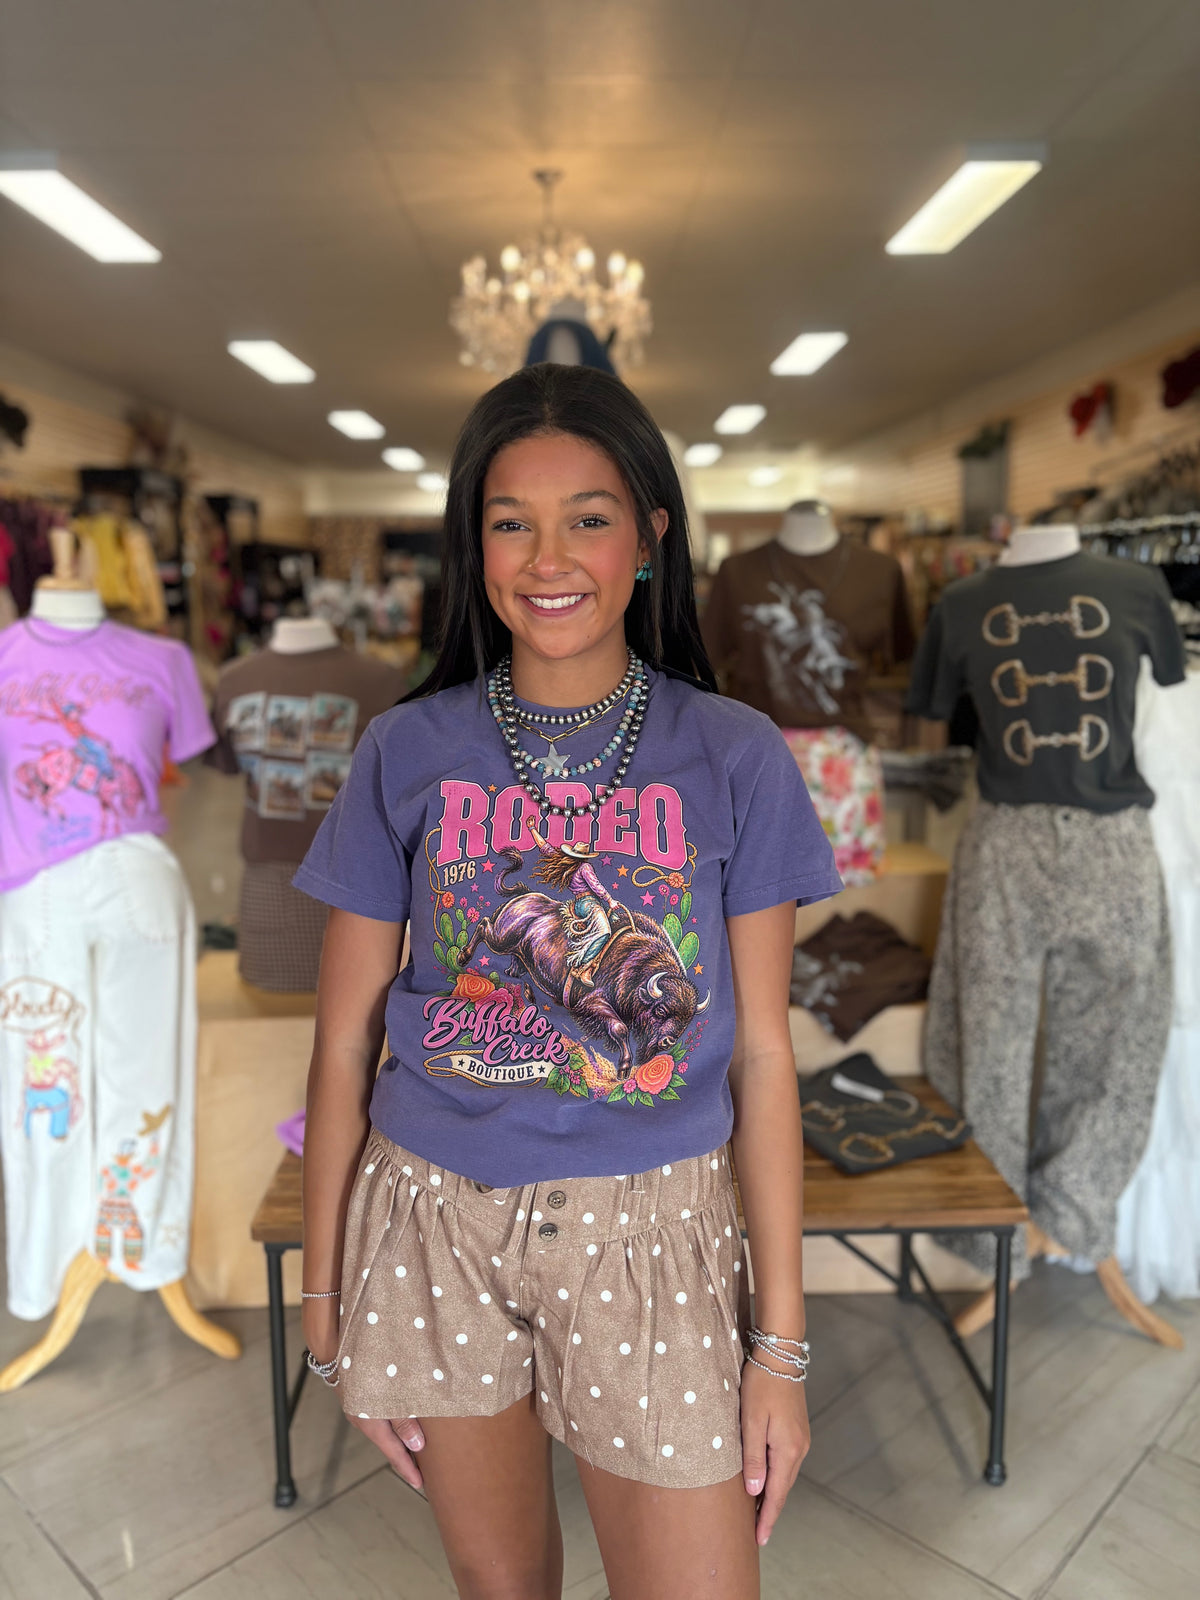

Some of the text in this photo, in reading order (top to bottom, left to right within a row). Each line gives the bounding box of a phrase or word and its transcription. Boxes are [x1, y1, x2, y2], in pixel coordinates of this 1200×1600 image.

[436, 780, 688, 871] RODEO
[443, 861, 477, 888] 1976
[422, 996, 554, 1050] Buffalo
[482, 1031, 570, 1067] Creek
[467, 1059, 535, 1081] BOUTIQUE
